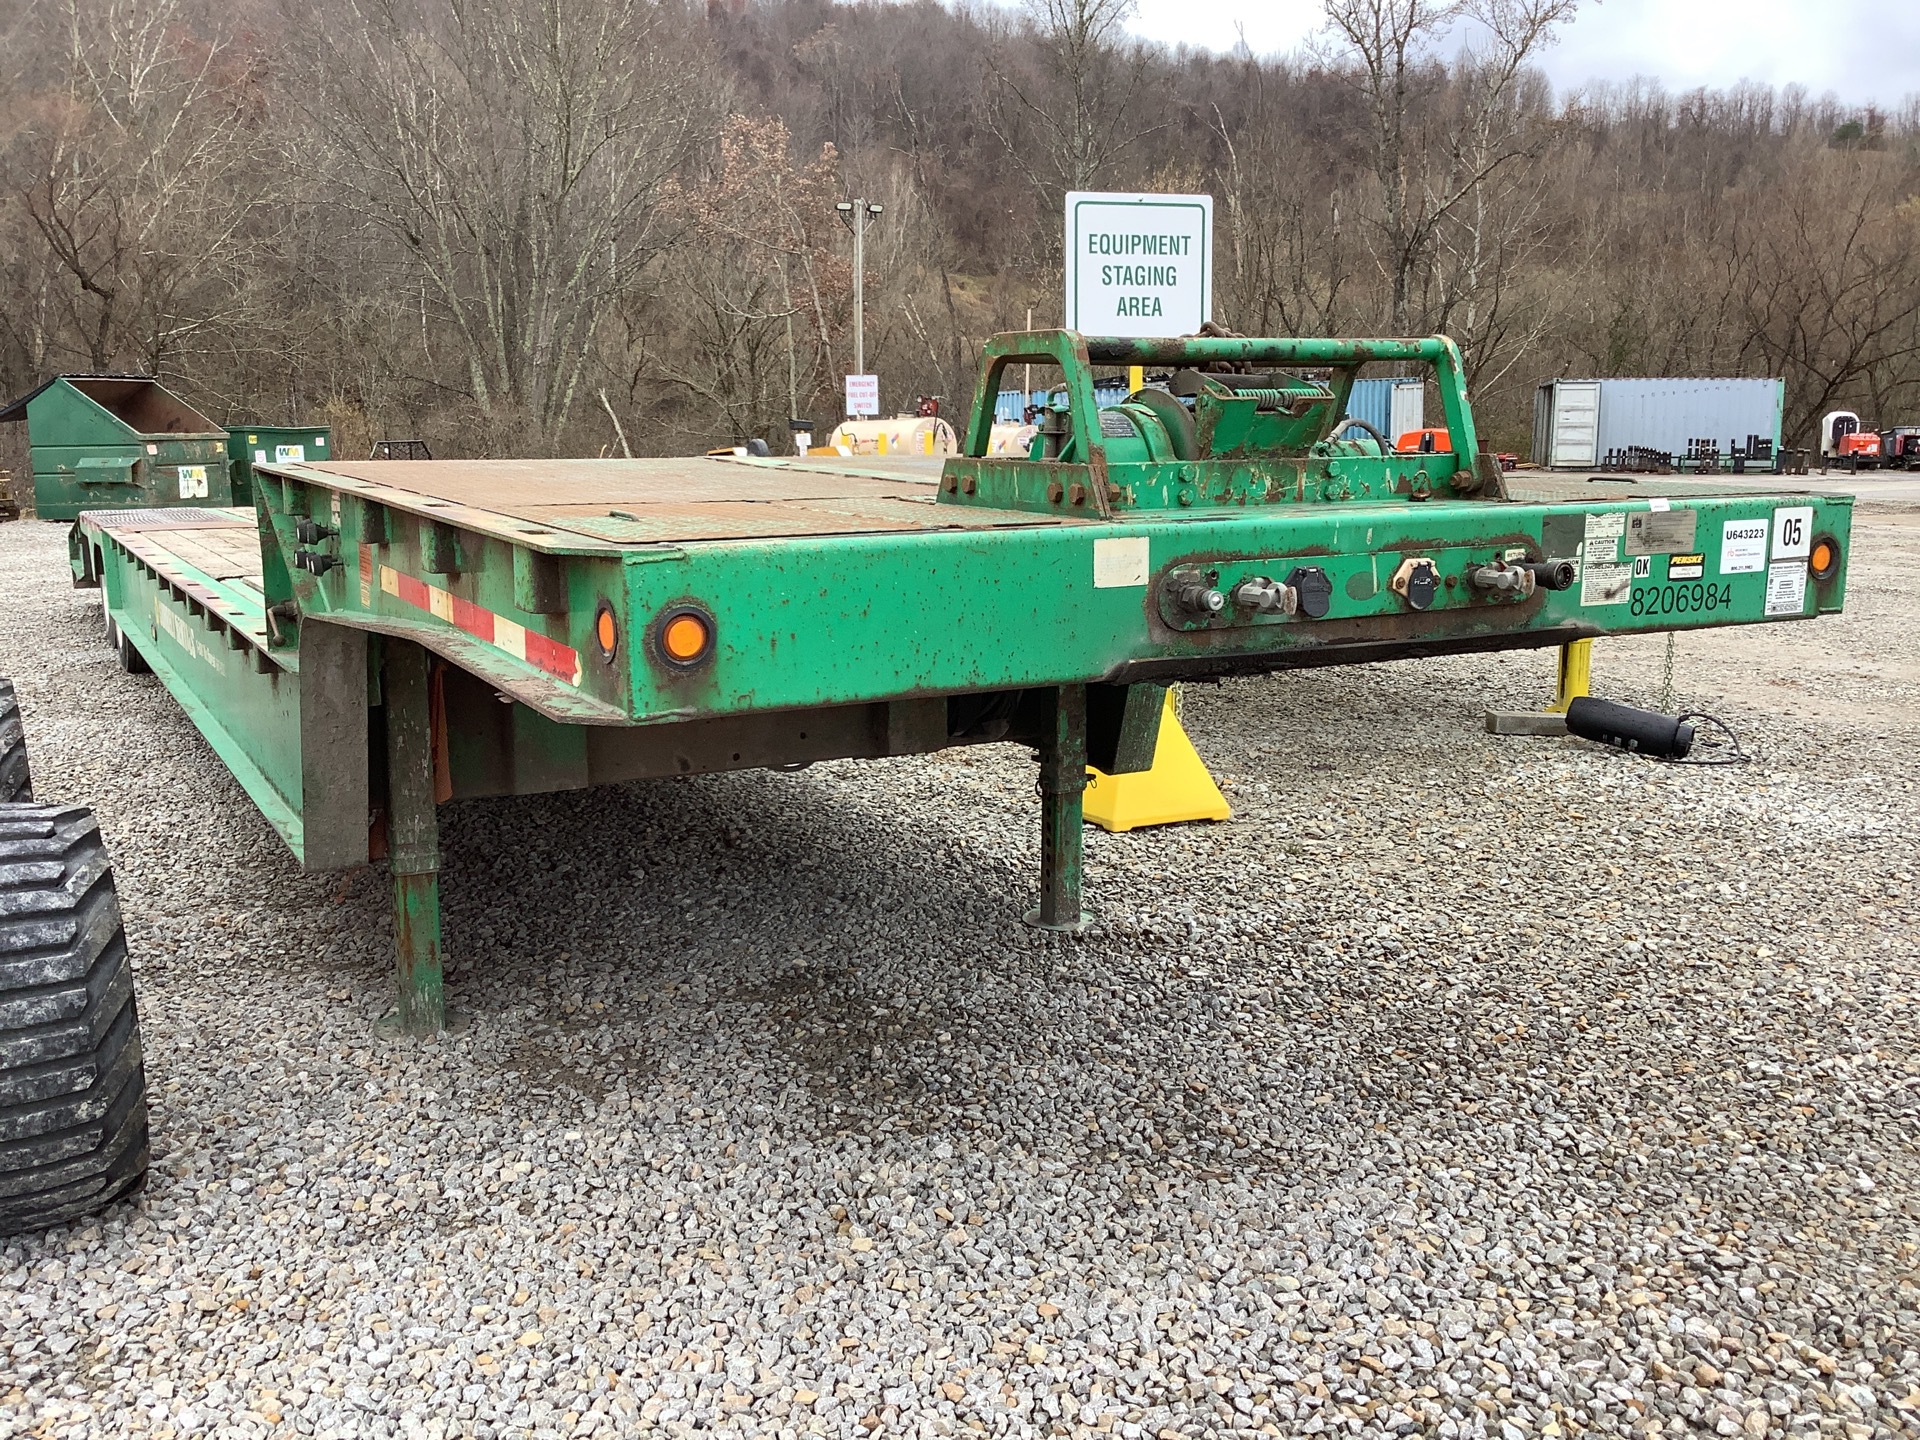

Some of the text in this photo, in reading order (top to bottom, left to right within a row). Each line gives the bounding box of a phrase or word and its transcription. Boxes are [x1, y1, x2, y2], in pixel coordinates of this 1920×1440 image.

[1088, 233, 1192, 256] EQUIPMENT
[1101, 264, 1177, 287] STAGING
[1116, 296, 1163, 317] AREA
[279, 447, 299, 456] WM
[182, 469, 203, 478] WM
[1726, 528, 1765, 541] U643223
[1783, 518, 1802, 546] 05
[1635, 558, 1650, 576] OK
[1670, 555, 1704, 565] PENSKE
[1630, 582, 1732, 617] 8206984
